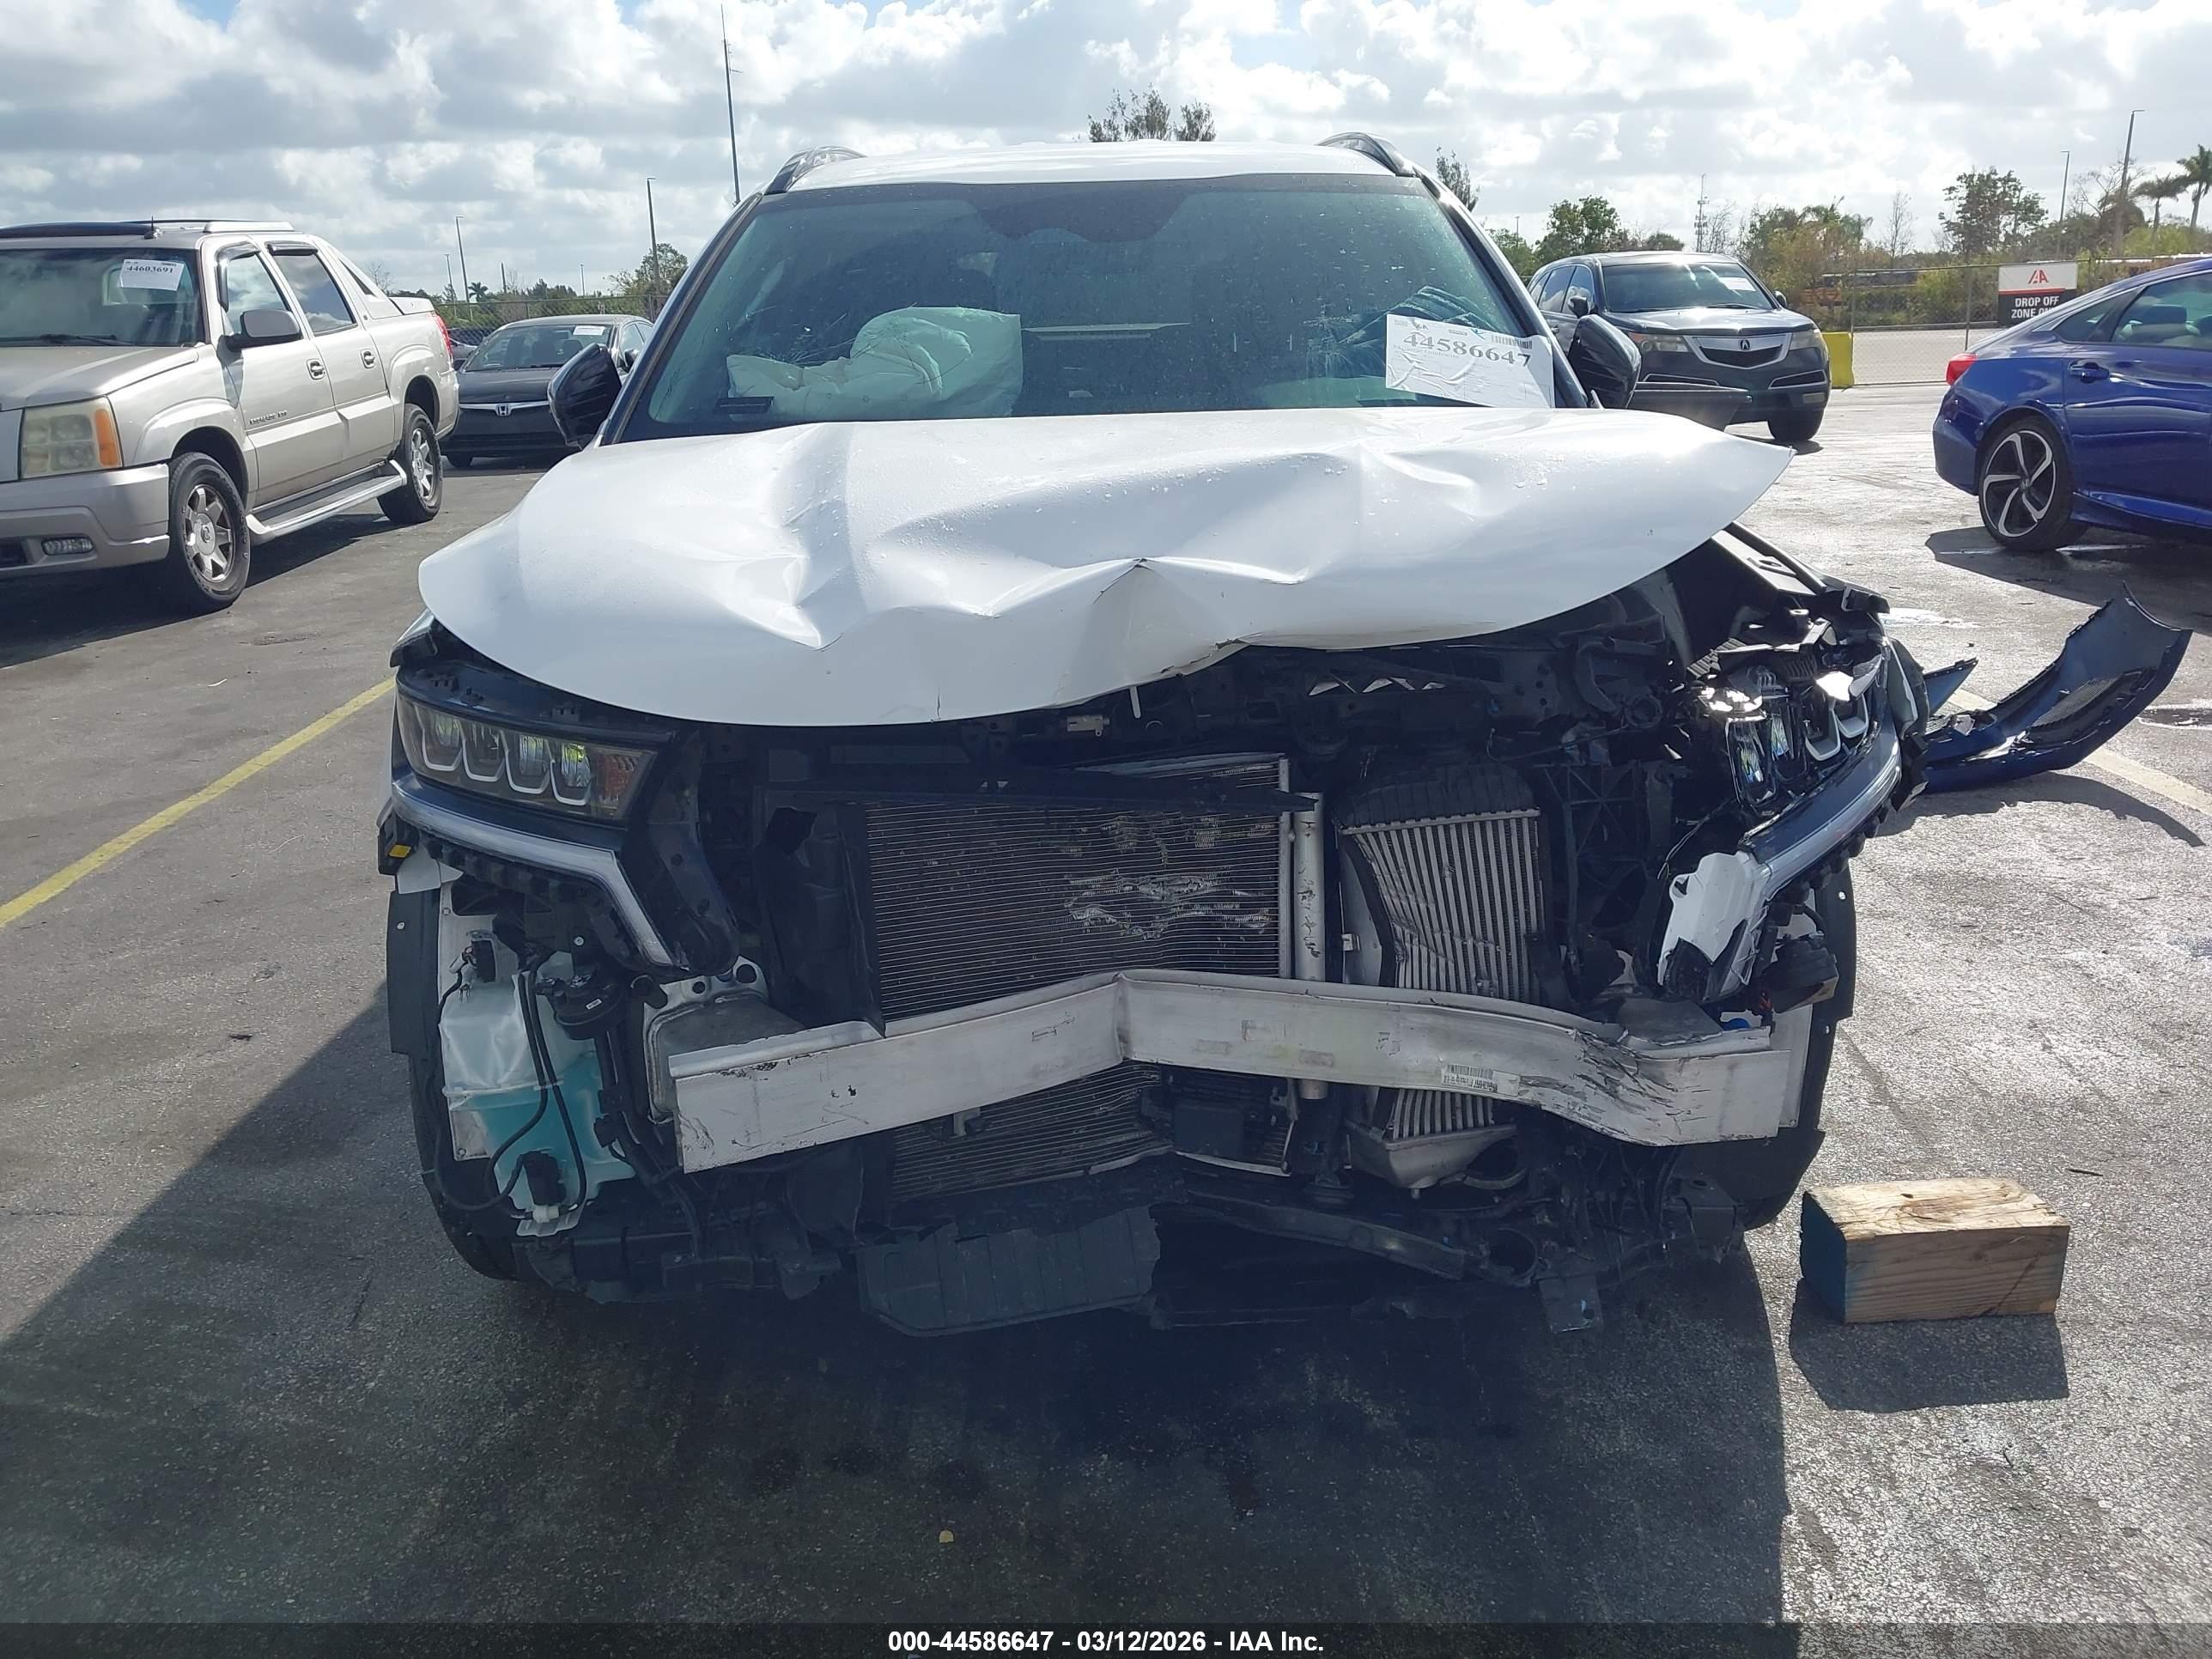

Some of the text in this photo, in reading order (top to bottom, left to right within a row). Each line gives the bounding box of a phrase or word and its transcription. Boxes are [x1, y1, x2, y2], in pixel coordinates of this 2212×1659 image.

[2014, 295, 2059, 307] DROP OFF
[2011, 307, 2036, 319] ZONE
[1403, 334, 1531, 367] 44586647
